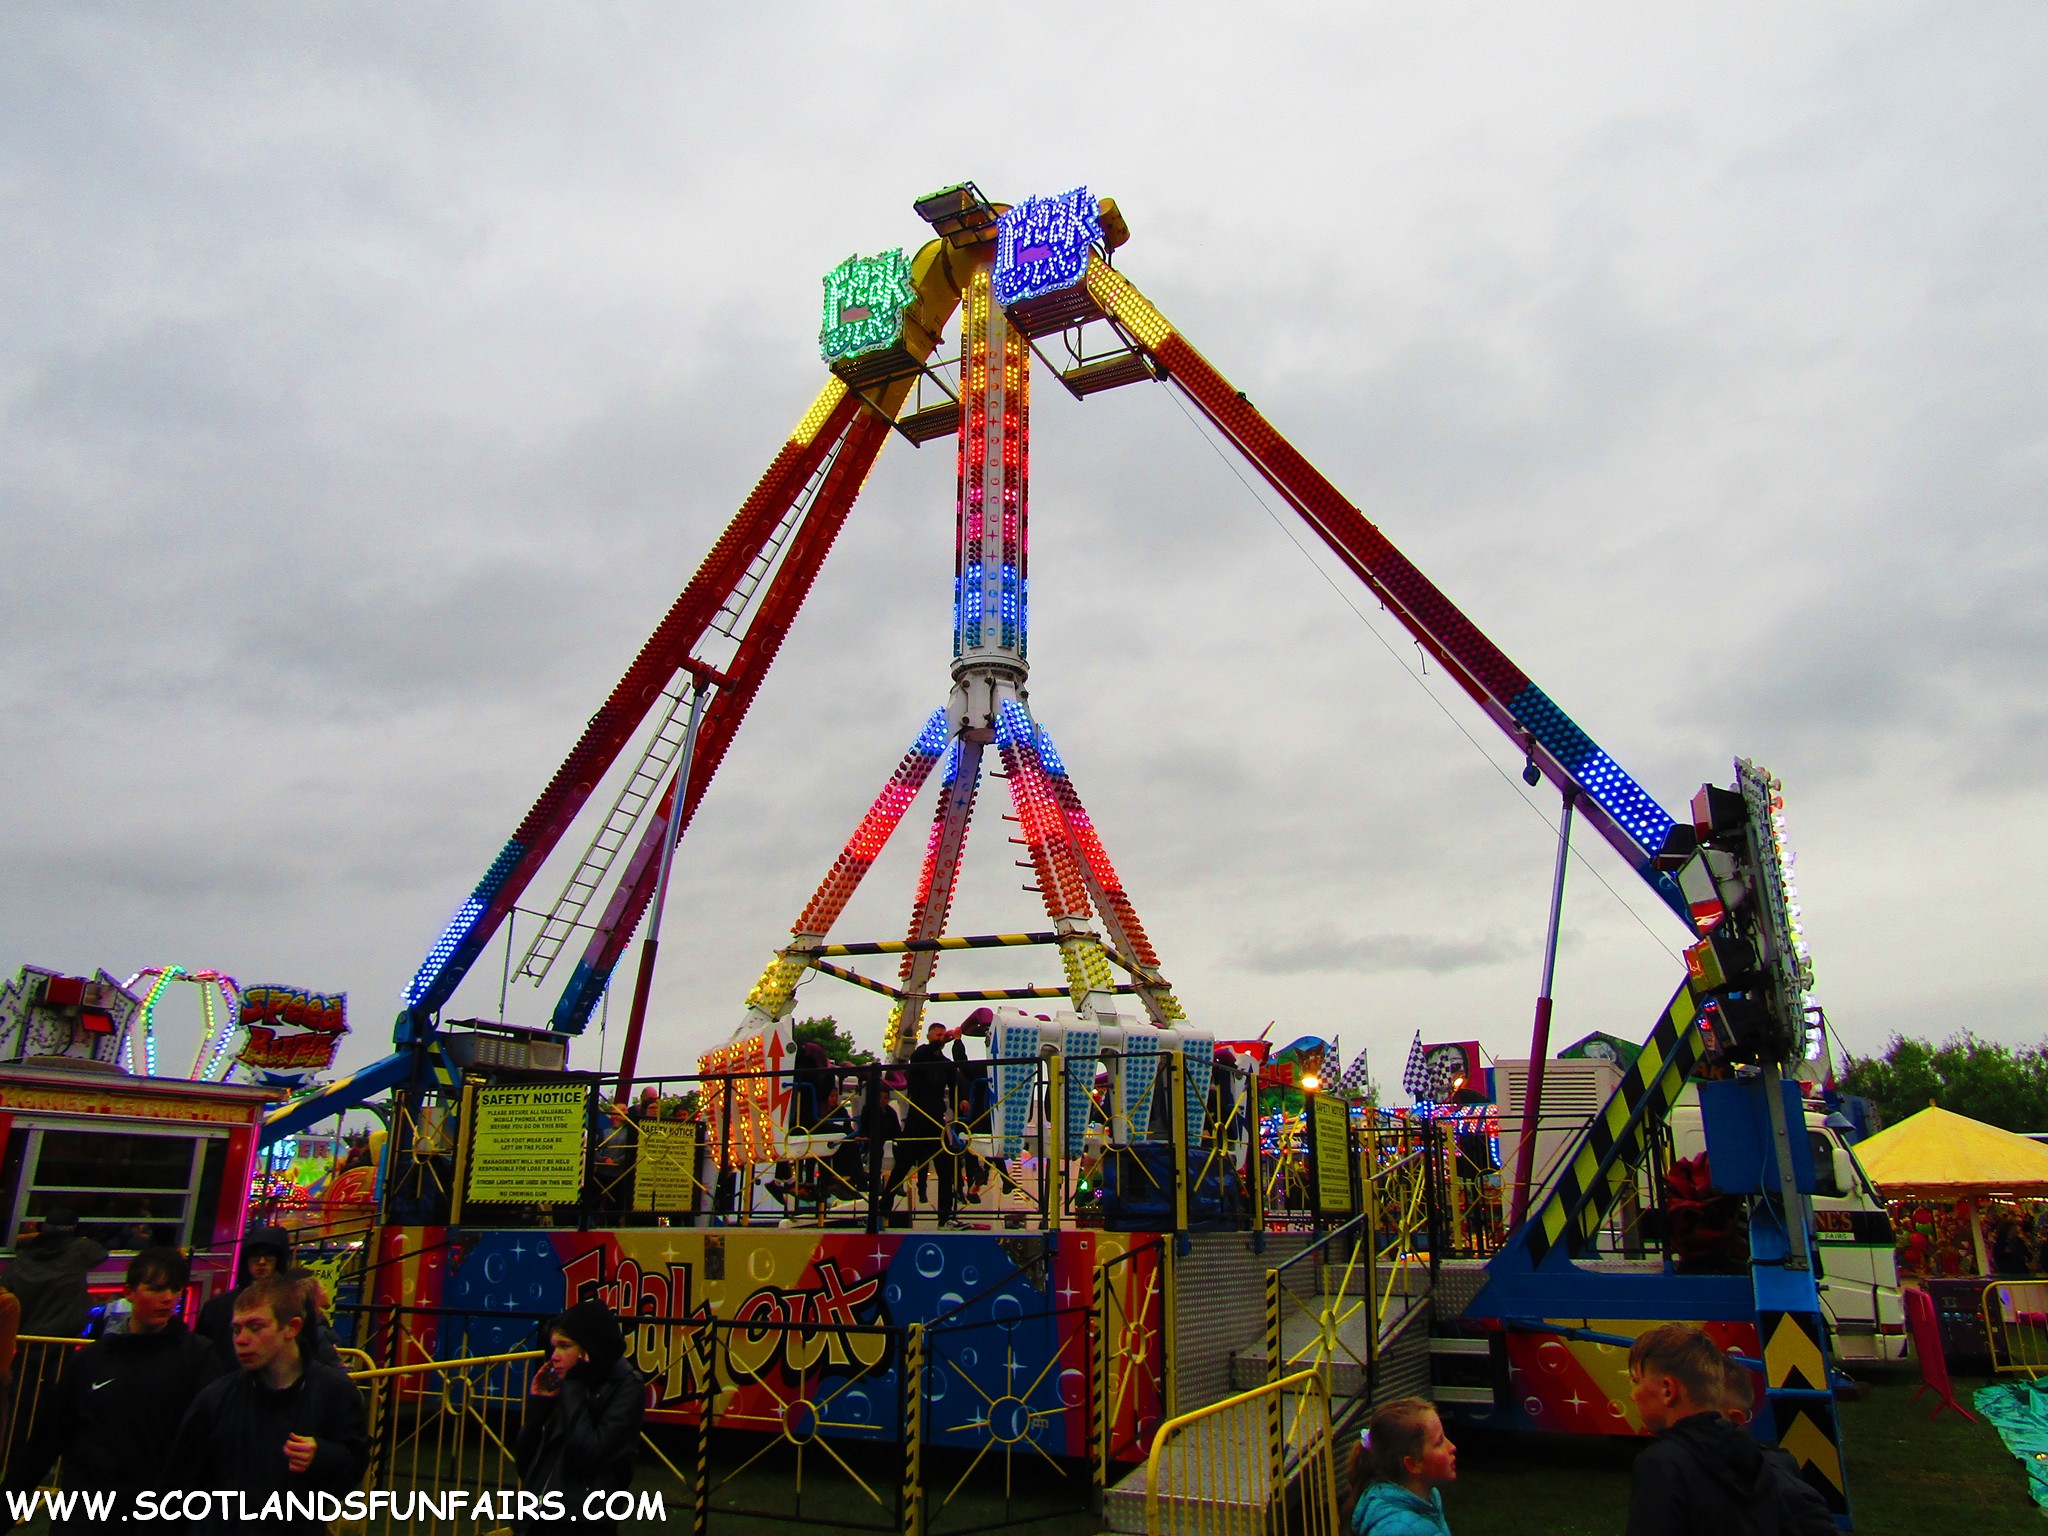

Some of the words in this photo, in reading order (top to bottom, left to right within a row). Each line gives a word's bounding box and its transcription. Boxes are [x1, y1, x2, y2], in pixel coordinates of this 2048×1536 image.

[482, 1094, 530, 1105] SAFETY
[533, 1092, 581, 1104] NOTICE
[669, 1127, 694, 1137] NOTICE
